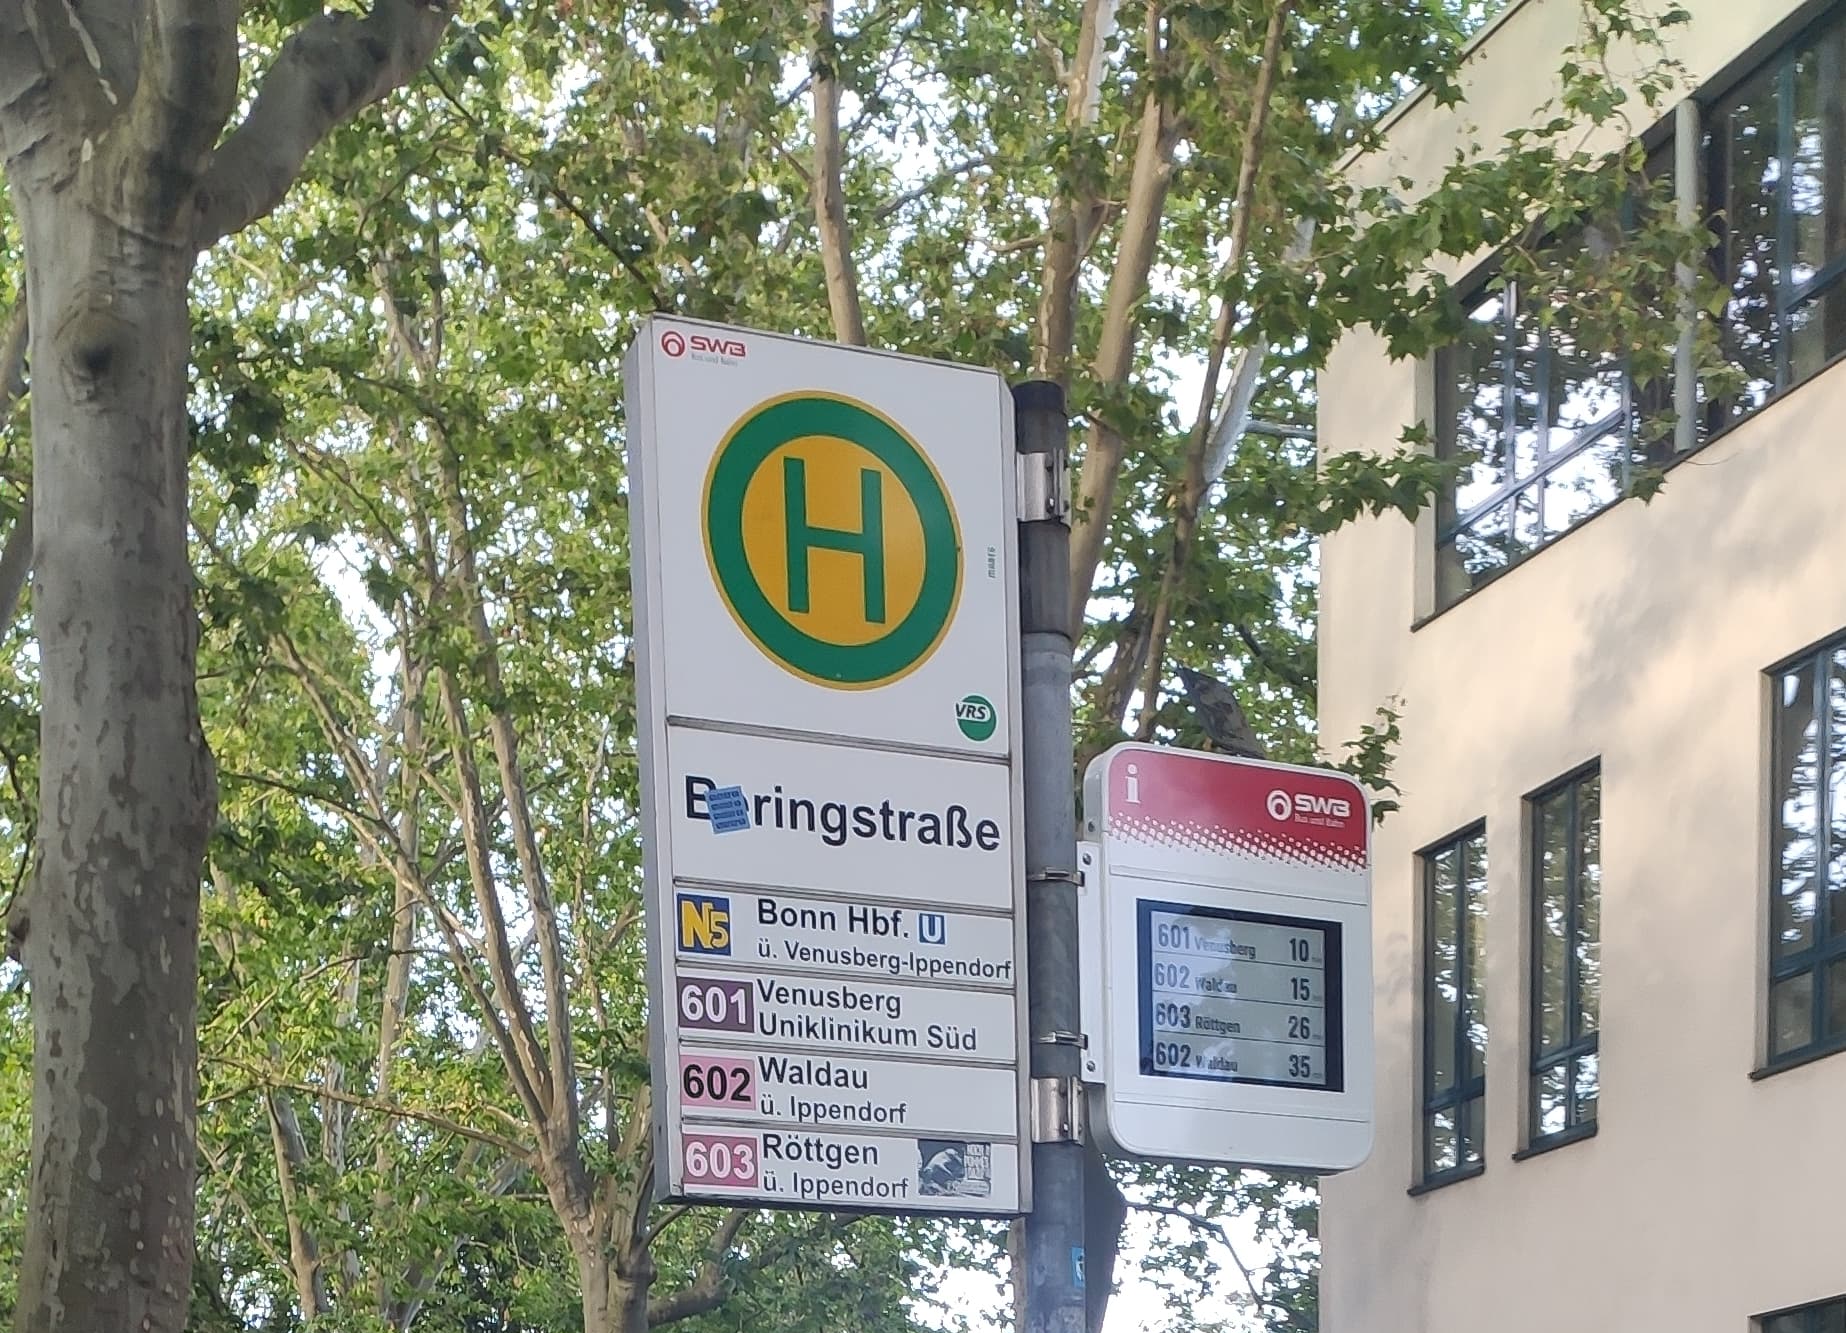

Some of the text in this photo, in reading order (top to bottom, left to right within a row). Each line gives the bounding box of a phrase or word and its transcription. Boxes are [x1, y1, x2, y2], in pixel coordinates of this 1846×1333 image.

[691, 336, 746, 357] SWB
[783, 456, 886, 624] H
[955, 701, 988, 722] VRS
[685, 775, 1001, 852] Bringstraße
[1294, 793, 1352, 818] SWB
[681, 899, 730, 949] N5
[758, 898, 836, 932] Bonn
[848, 906, 909, 939] Hbf.
[758, 939, 1011, 980] ü. Venusberg-Ippendorf
[1157, 923, 1191, 950] 601
[1289, 937, 1310, 963] 10
[757, 978, 902, 1019] Venusberg
[1154, 962, 1191, 989] 602
[1290, 976, 1311, 1001] 15
[681, 985, 748, 1026] 601
[1155, 1003, 1310, 1040] 603 Röttgen 26
[758, 1012, 977, 1052] Uniklinikum Süd
[758, 1056, 869, 1090] Waldau
[1155, 1042, 1192, 1068] 602
[1288, 1054, 1311, 1079] 35
[682, 1064, 752, 1103] 602
[760, 1094, 907, 1126] ü. Ippendorf
[685, 1141, 755, 1181] 603
[763, 1132, 879, 1169] Röttgen
[763, 1171, 909, 1201] ü. Ippendorf
